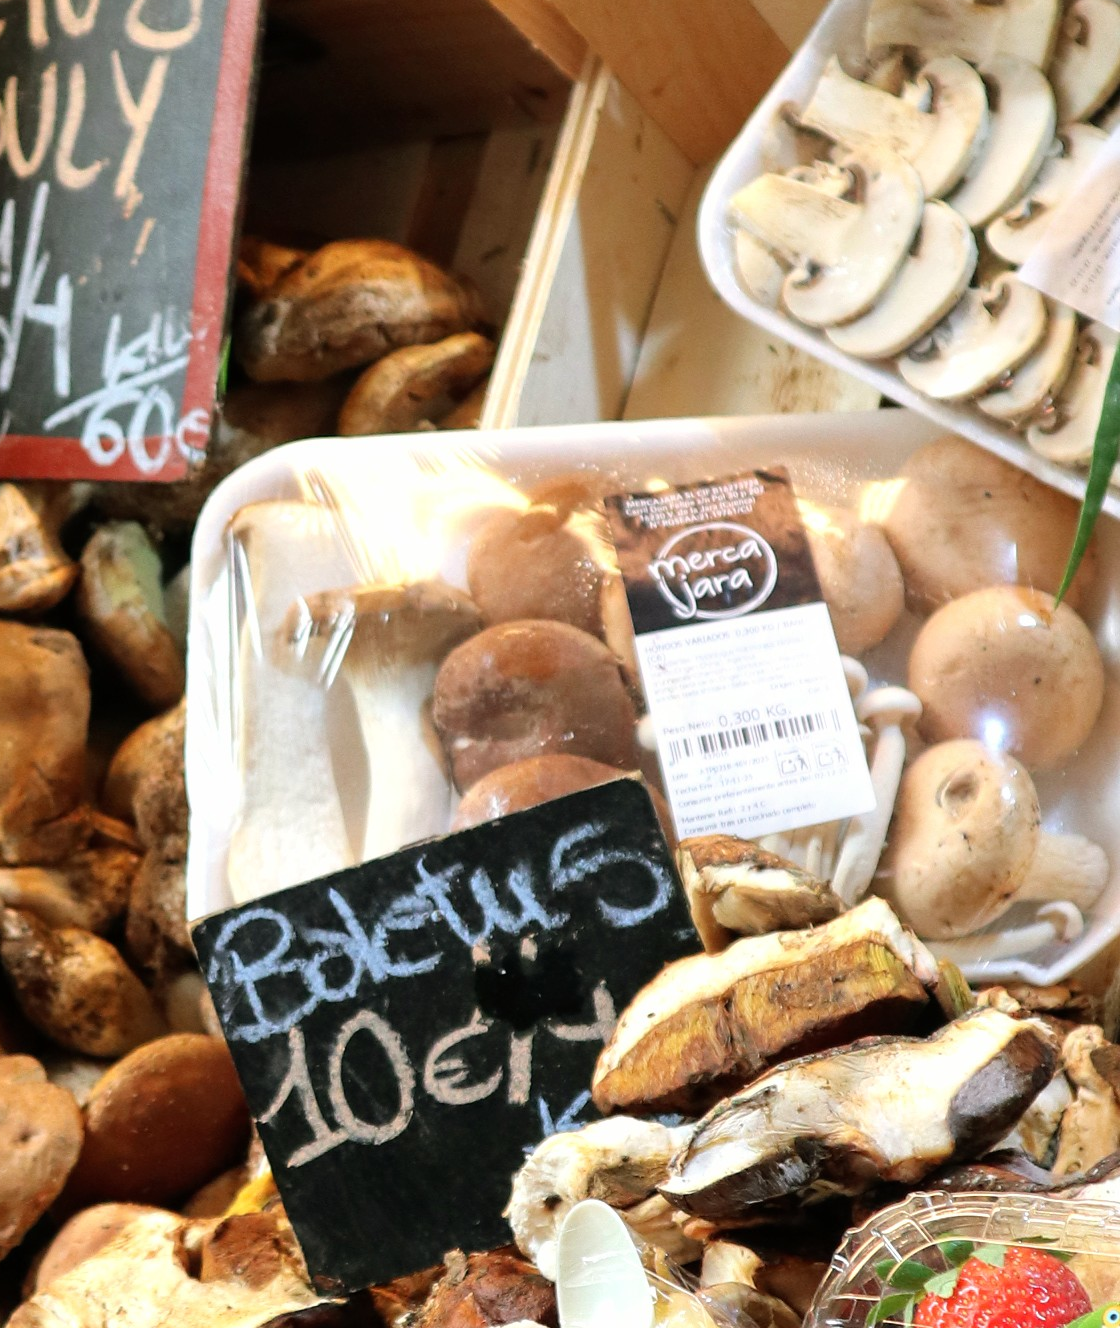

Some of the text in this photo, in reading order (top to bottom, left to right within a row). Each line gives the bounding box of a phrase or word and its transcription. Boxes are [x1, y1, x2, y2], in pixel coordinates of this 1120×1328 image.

[648, 538, 764, 581] merca
[677, 565, 754, 614] jara
[717, 708, 761, 728] 0,300
